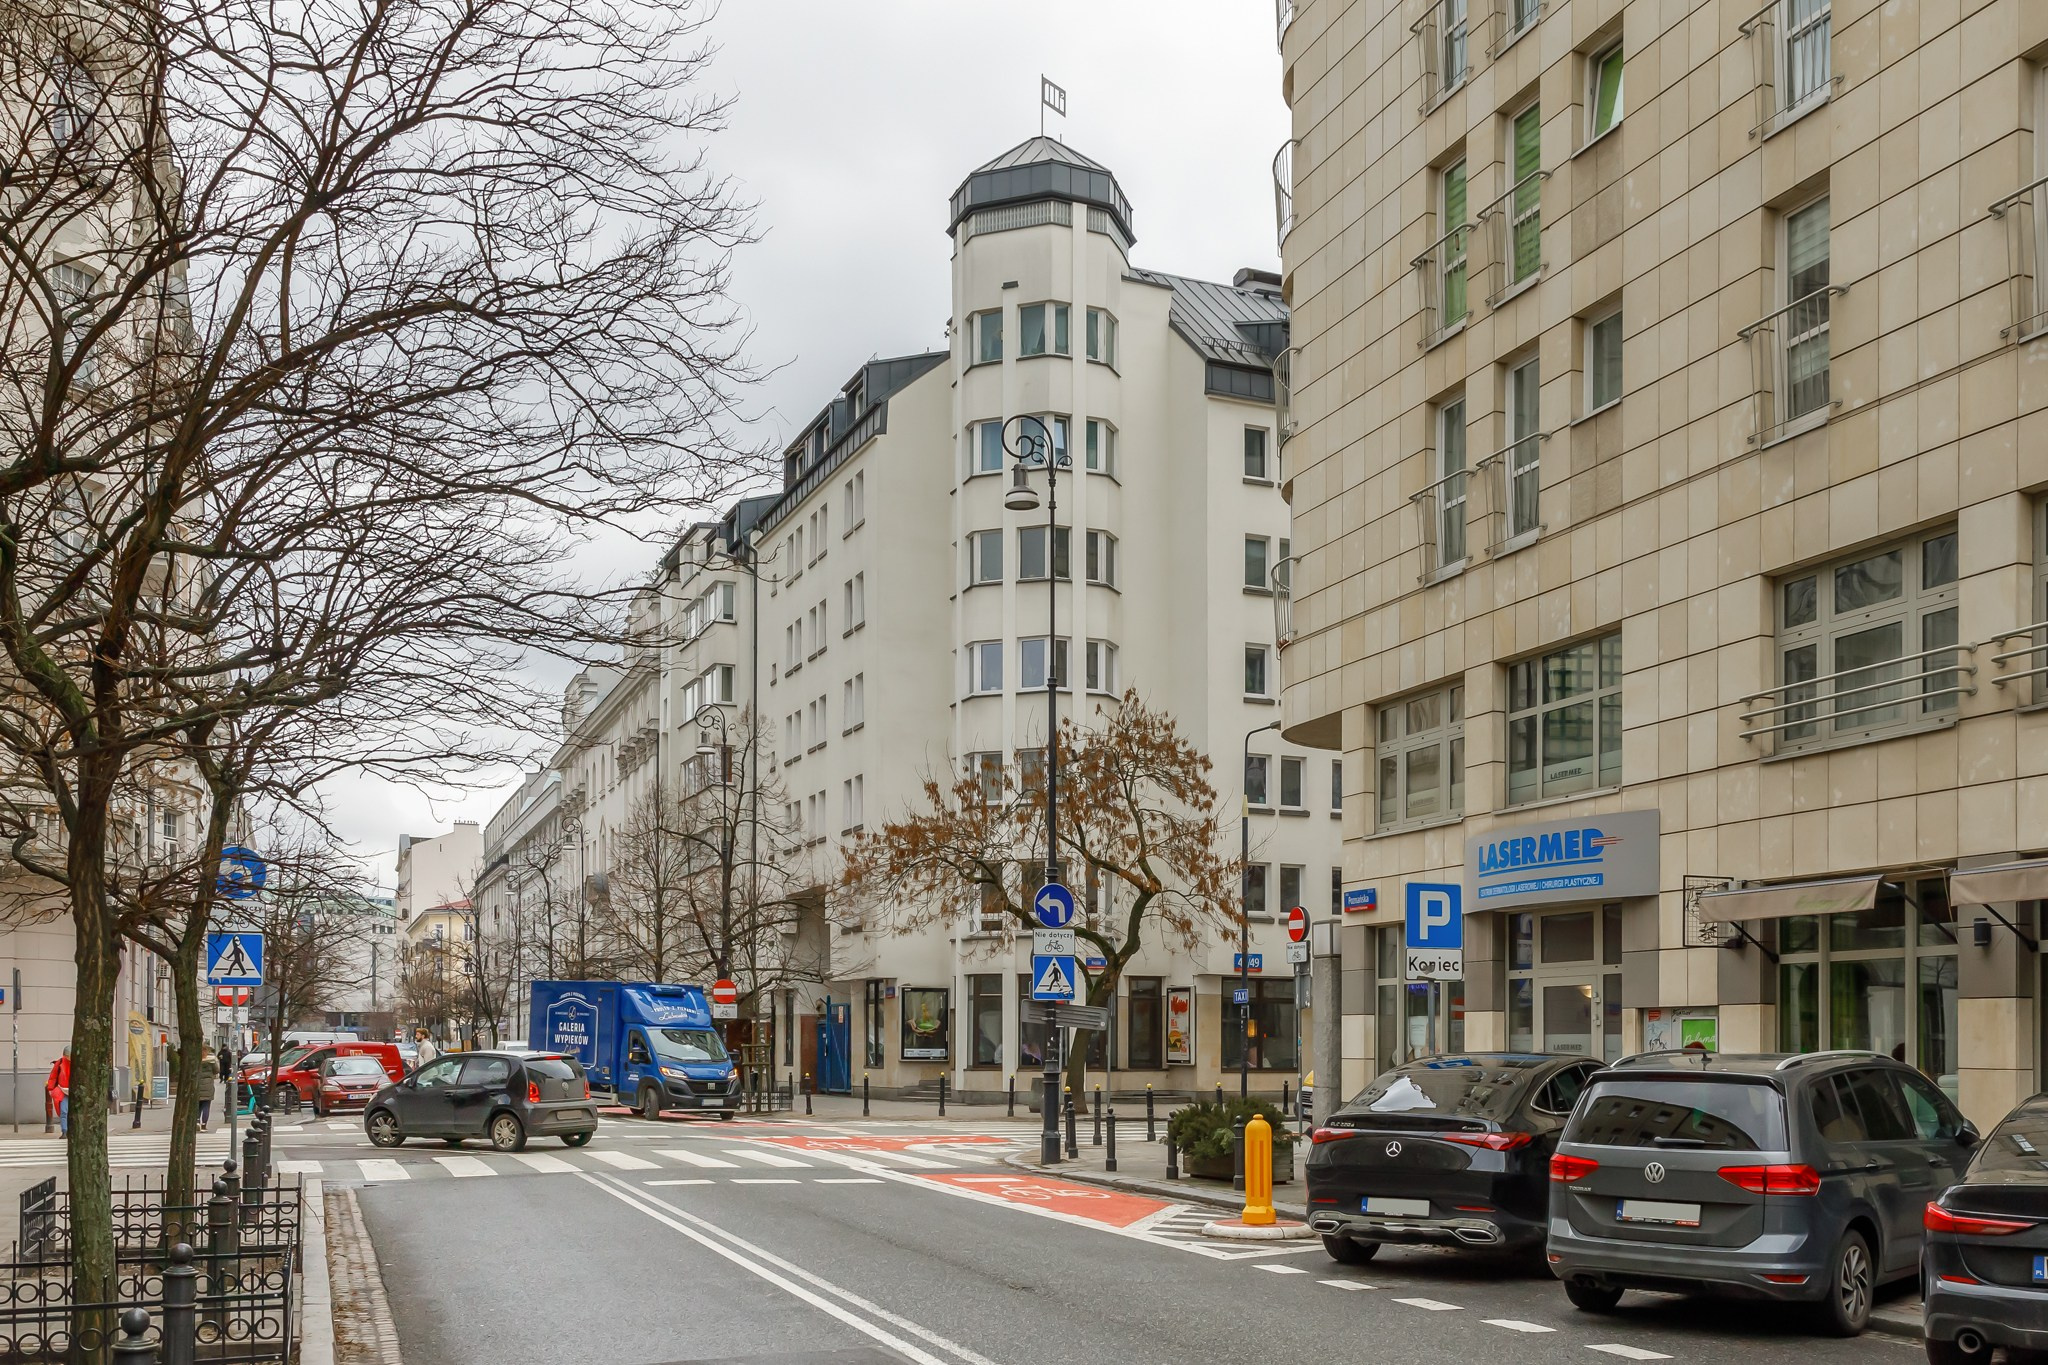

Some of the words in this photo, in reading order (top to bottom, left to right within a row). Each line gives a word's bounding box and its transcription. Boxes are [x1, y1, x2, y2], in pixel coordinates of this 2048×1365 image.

[1478, 828, 1605, 873] LASERMED
[1564, 876, 1600, 887] PLASTYCZNEJ
[1419, 890, 1451, 940] P
[1408, 956, 1460, 972] Koniec
[558, 1022, 585, 1032] GALERIA
[554, 1034, 589, 1046] WYPIEKÓW
